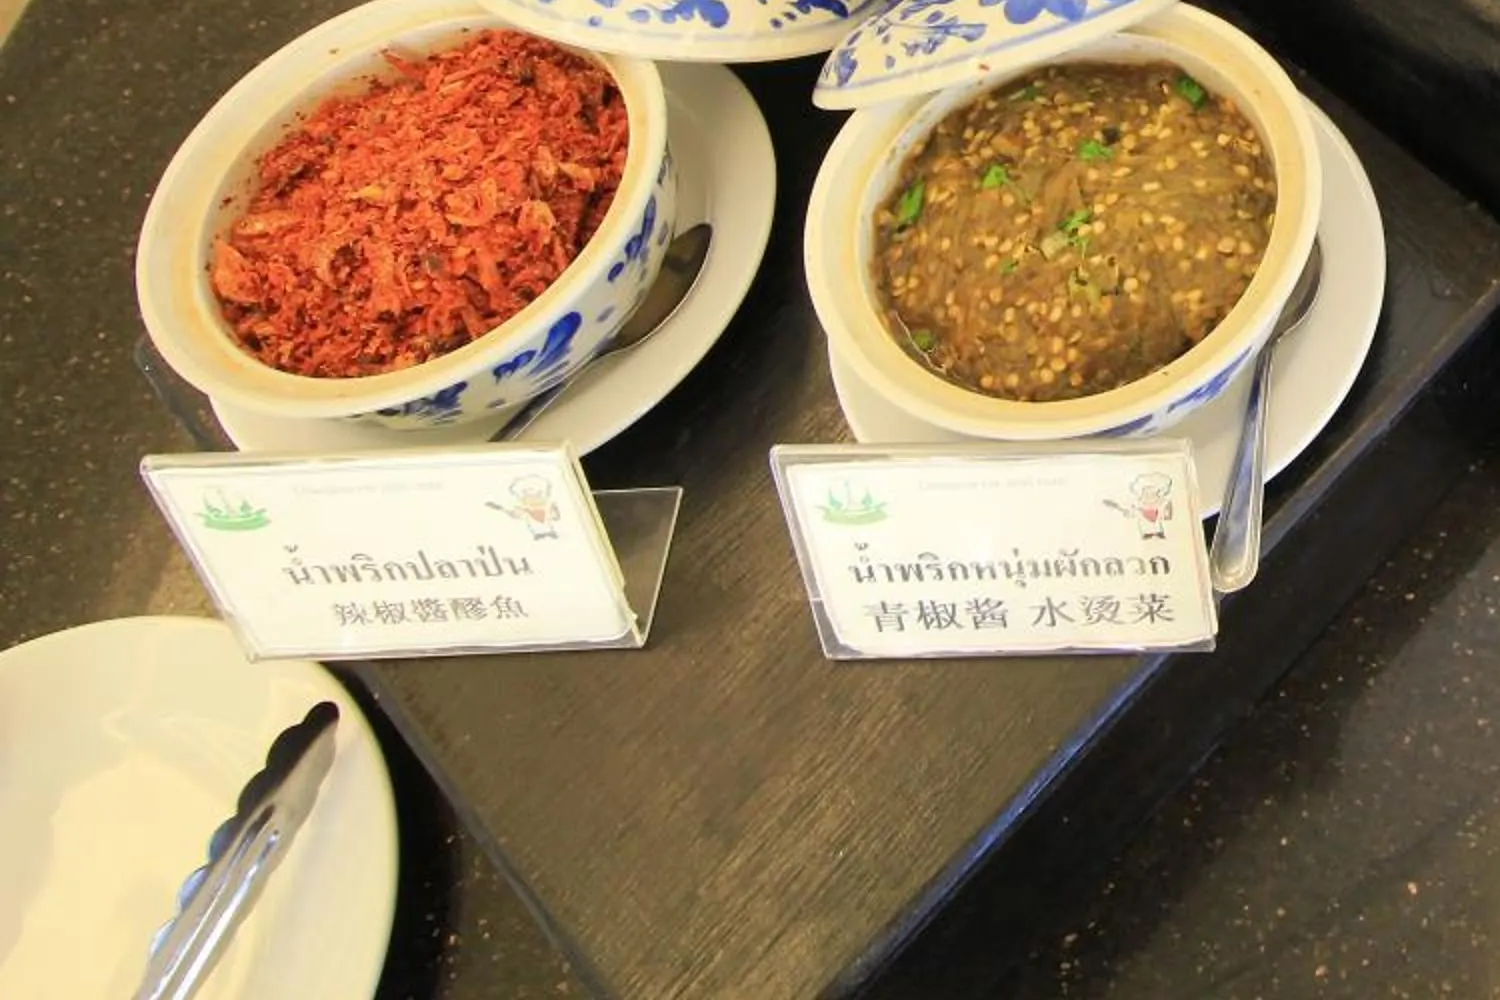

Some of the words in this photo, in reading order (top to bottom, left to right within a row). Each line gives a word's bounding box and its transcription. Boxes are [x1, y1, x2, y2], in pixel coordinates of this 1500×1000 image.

[281, 544, 533, 586] น้ำพริกปลาป่น
